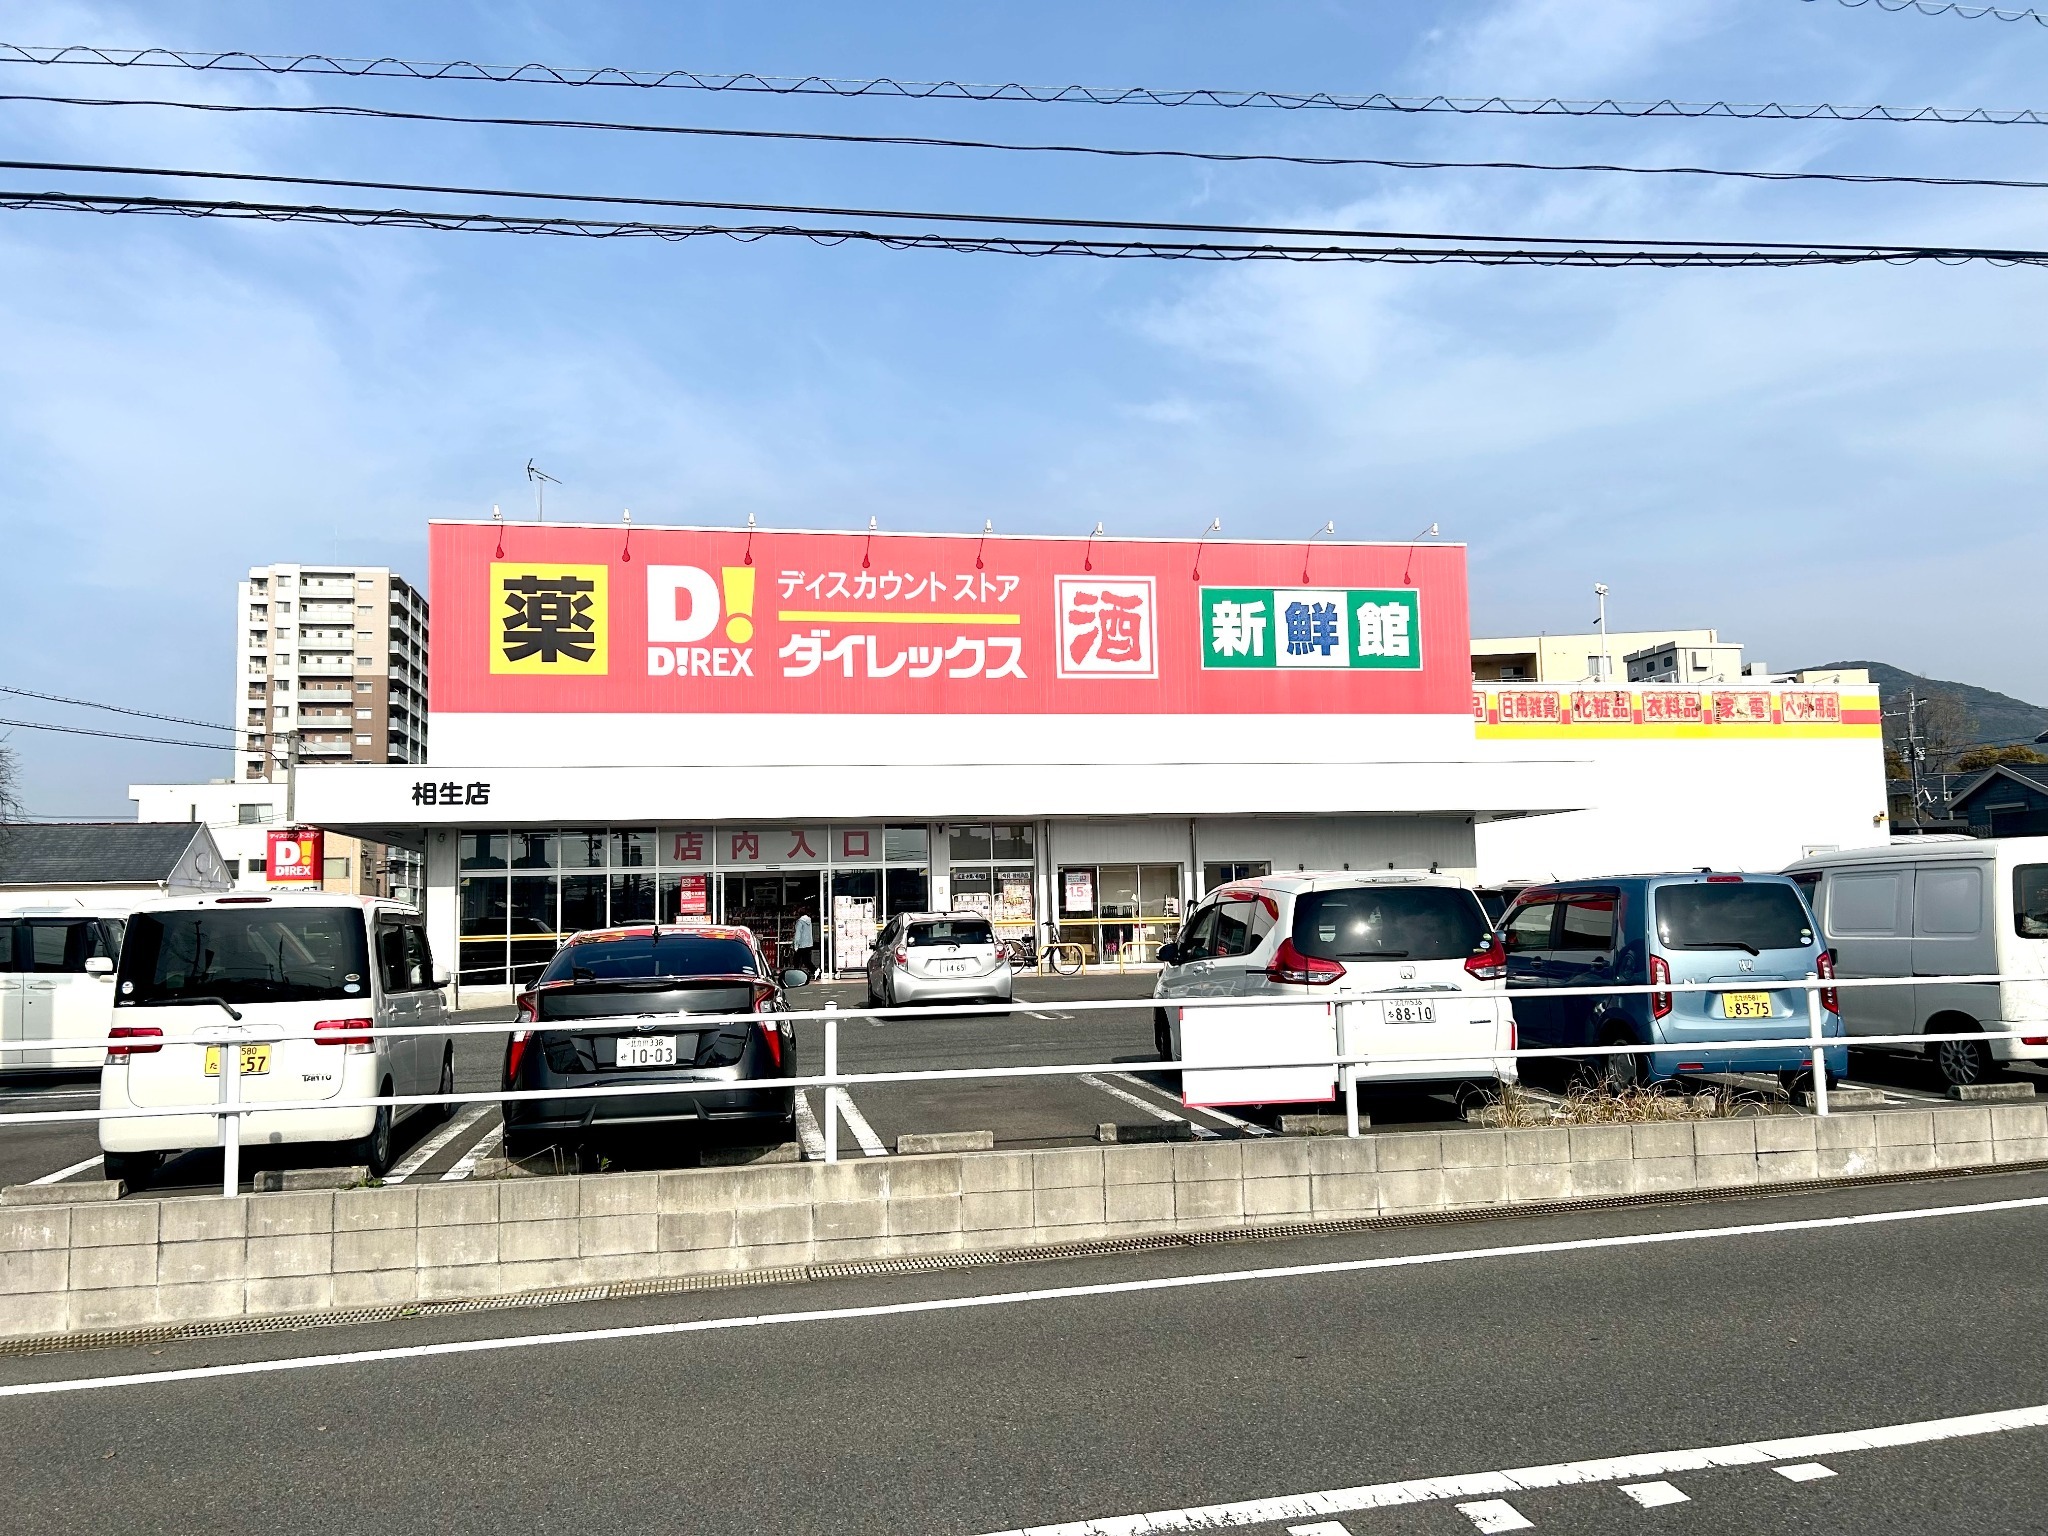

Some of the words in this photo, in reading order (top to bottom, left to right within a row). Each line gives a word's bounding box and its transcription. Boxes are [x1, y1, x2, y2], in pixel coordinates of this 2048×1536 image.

[778, 570, 947, 602] ディスカウント
[953, 572, 1020, 603] ストア
[502, 575, 596, 663] 薬
[1068, 590, 1144, 665] 酒
[1211, 599, 1410, 657] 新鮮館
[778, 629, 1028, 679] ダイレックス
[1502, 696, 1556, 718] 日用雑貨
[1576, 696, 1629, 718] 化粧品
[1646, 696, 1699, 719] 衣料品
[1718, 696, 1765, 719] 家電
[1785, 696, 1837, 719] ペット用品
[411, 781, 491, 807] 相生店
[673, 830, 870, 861] 店内入口
[1395, 1006, 1432, 1021] 88-10
[1735, 1002, 1769, 1016] 85-75
[241, 1046, 258, 1056] 580
[632, 1047, 673, 1064] 10-03
